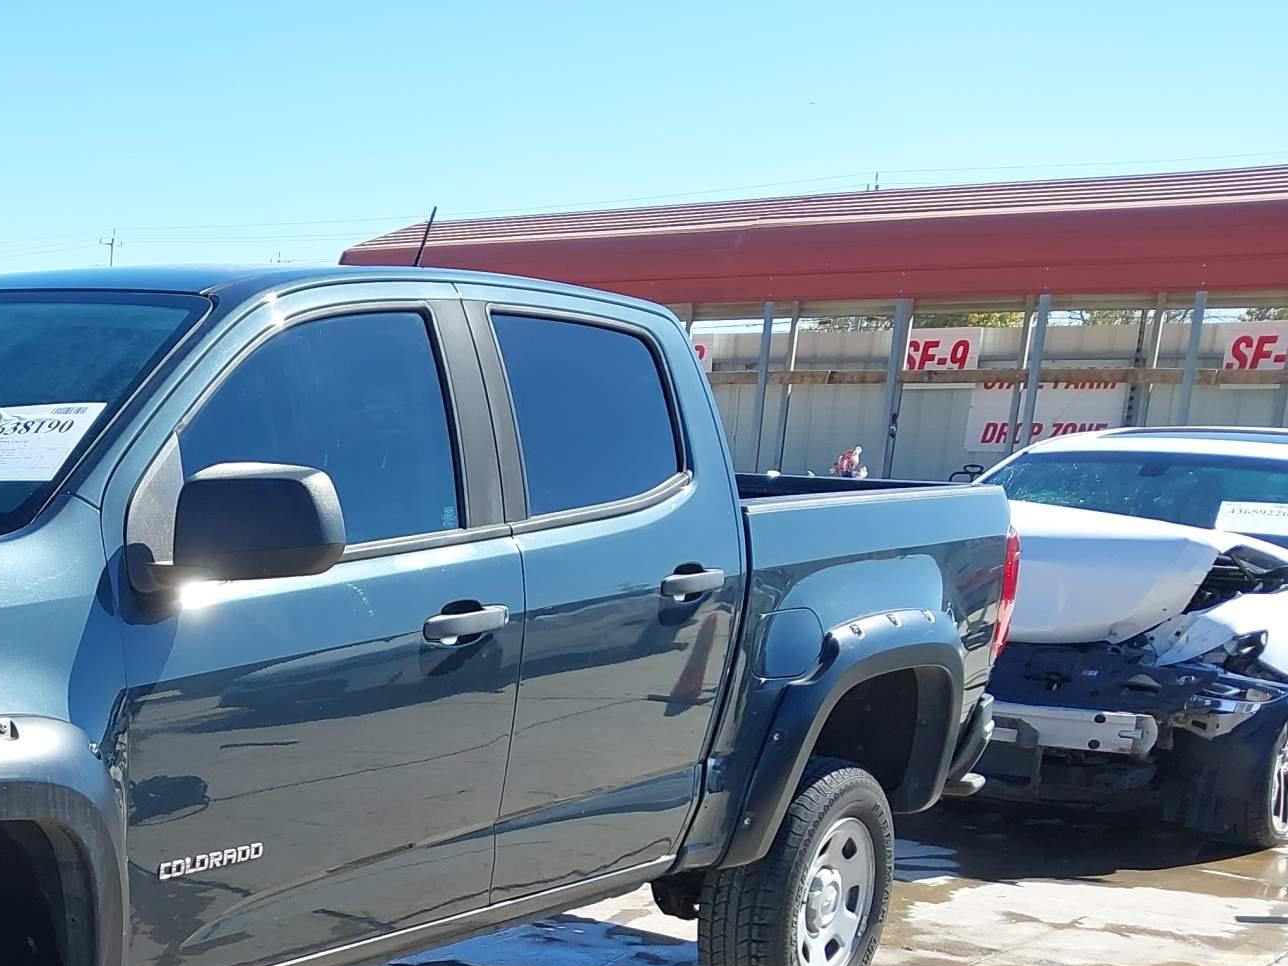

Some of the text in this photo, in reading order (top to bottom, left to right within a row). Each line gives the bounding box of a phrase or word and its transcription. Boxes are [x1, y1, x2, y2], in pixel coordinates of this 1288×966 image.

[907, 339, 970, 370] SF-9
[981, 422, 1044, 444] DROP
[159, 842, 264, 880] COLORADO
